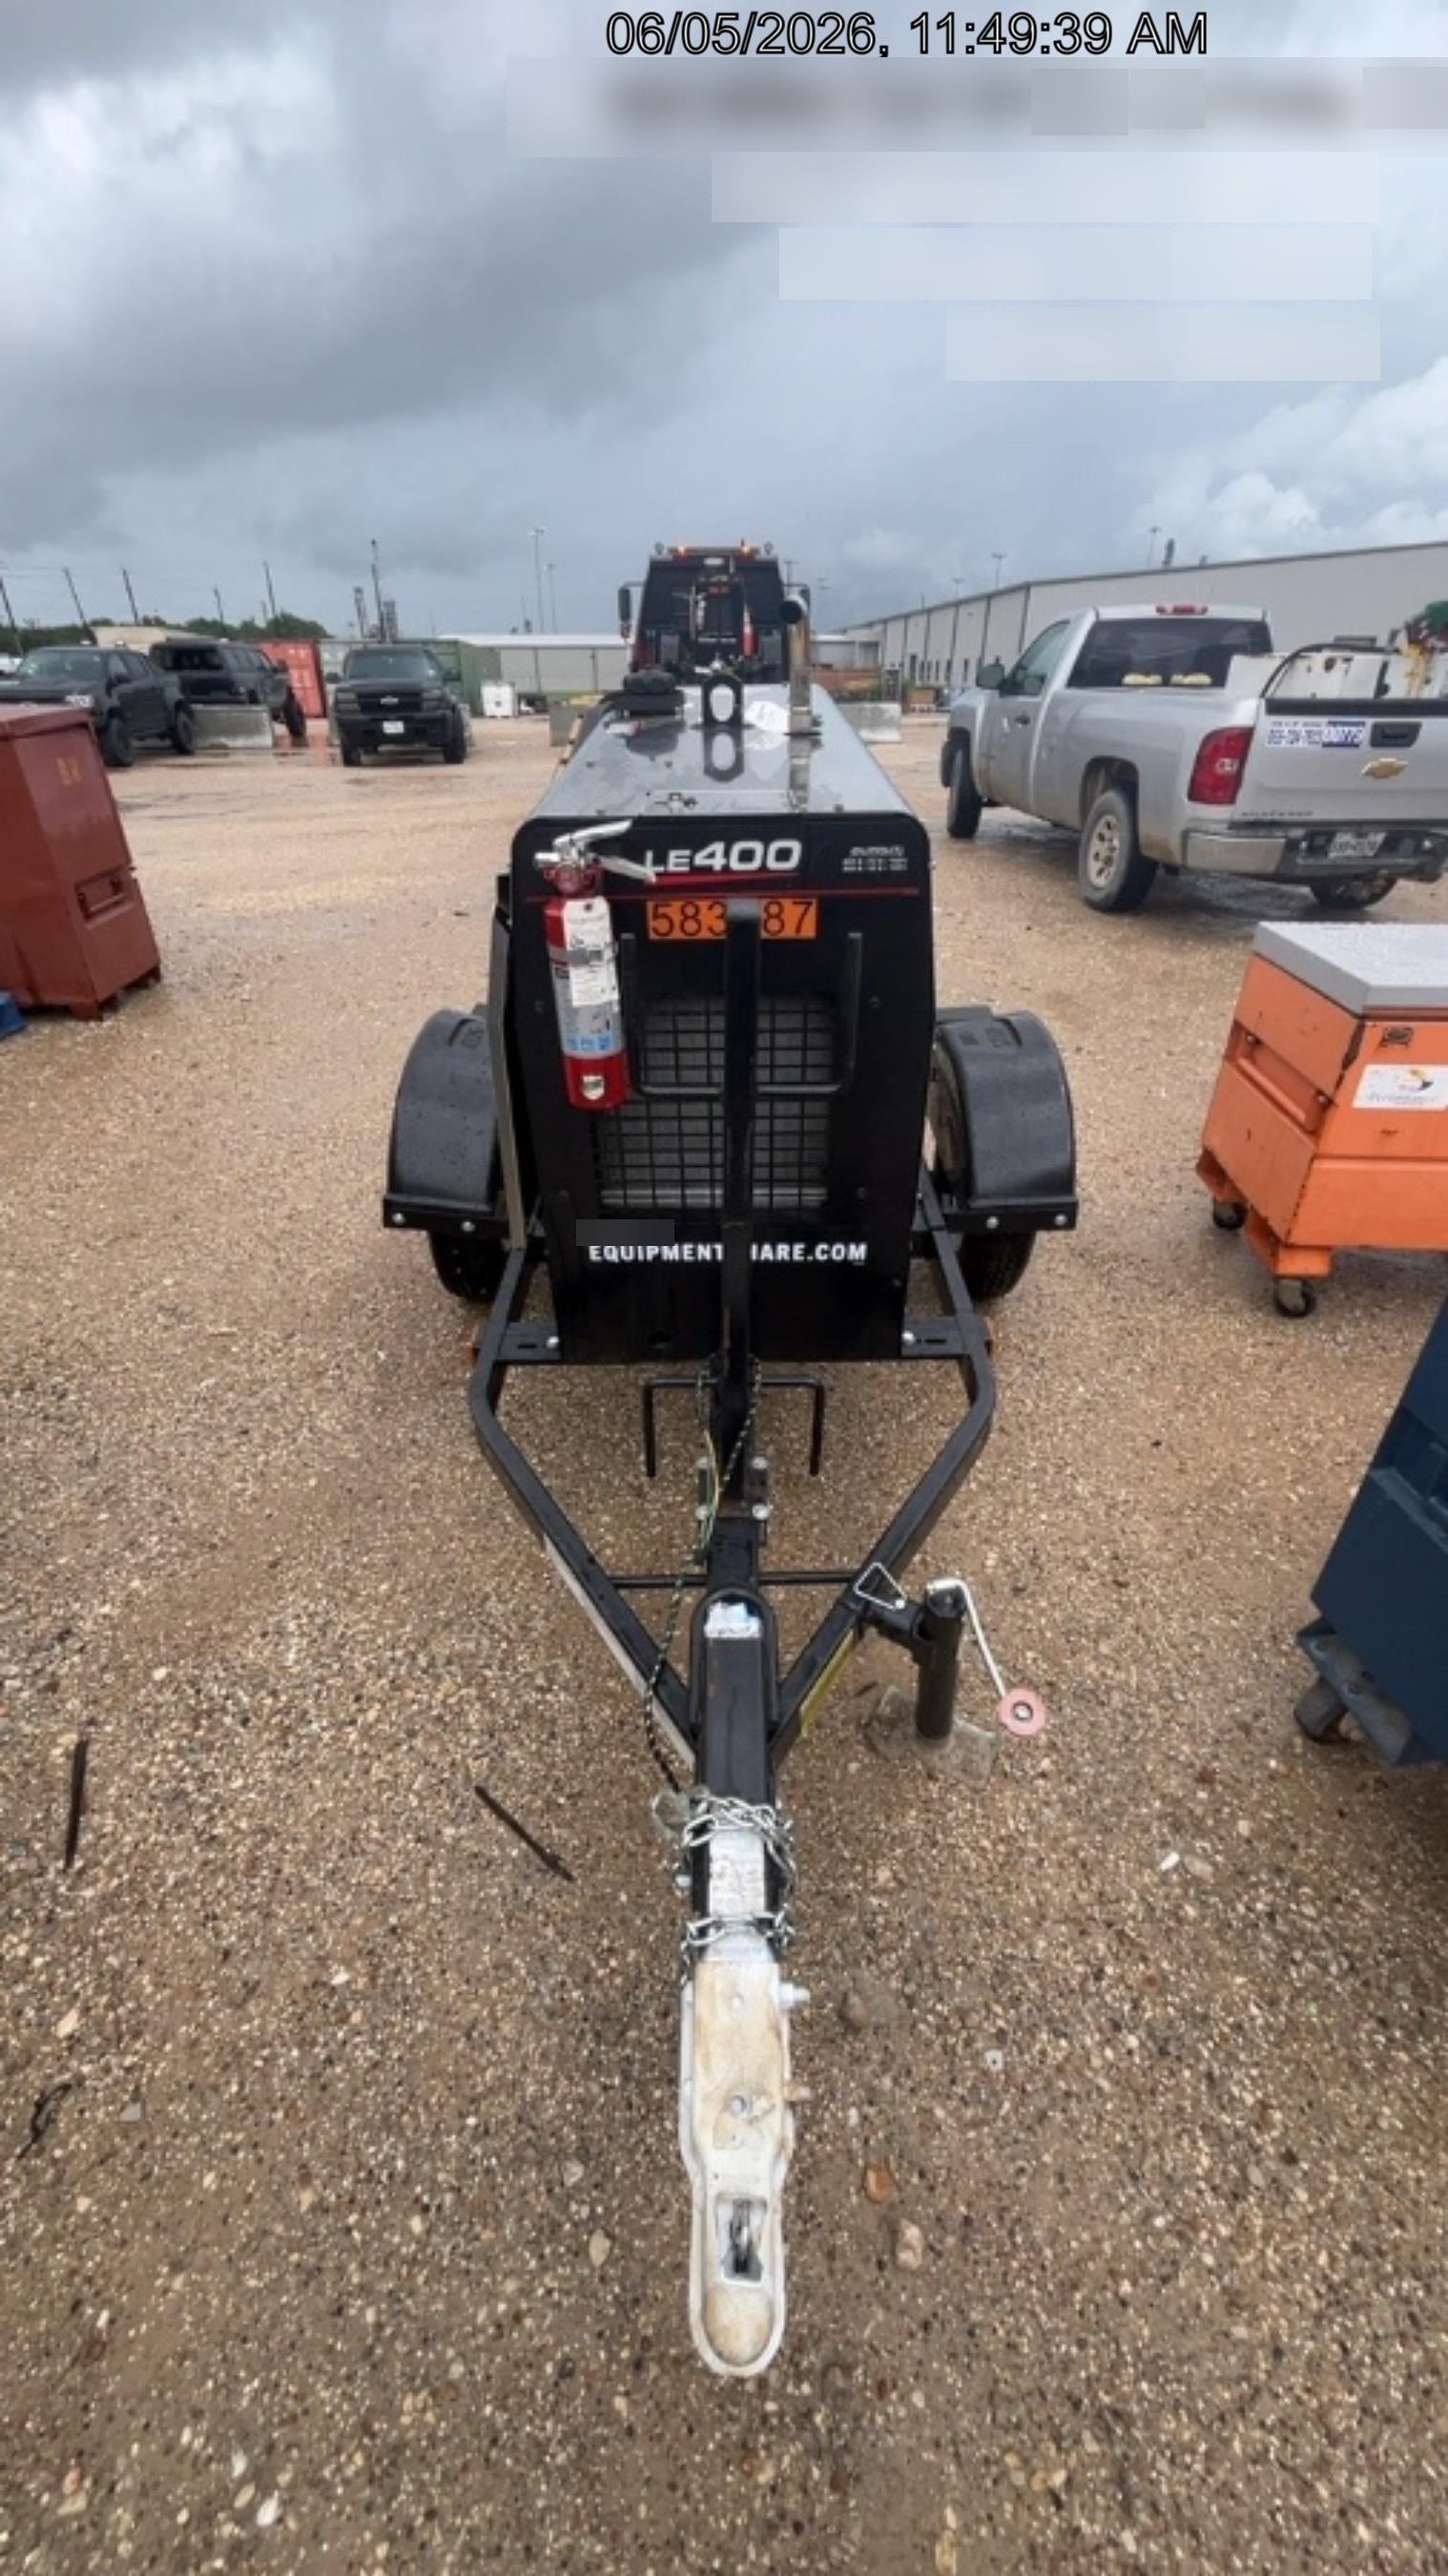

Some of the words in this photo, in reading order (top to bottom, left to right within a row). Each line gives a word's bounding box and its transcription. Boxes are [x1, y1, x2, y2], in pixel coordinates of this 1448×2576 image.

[644, 838, 803, 873] LE400
[651, 900, 815, 938] 58387
[588, 1242, 867, 1264] EQUIPMENTARE.COM
